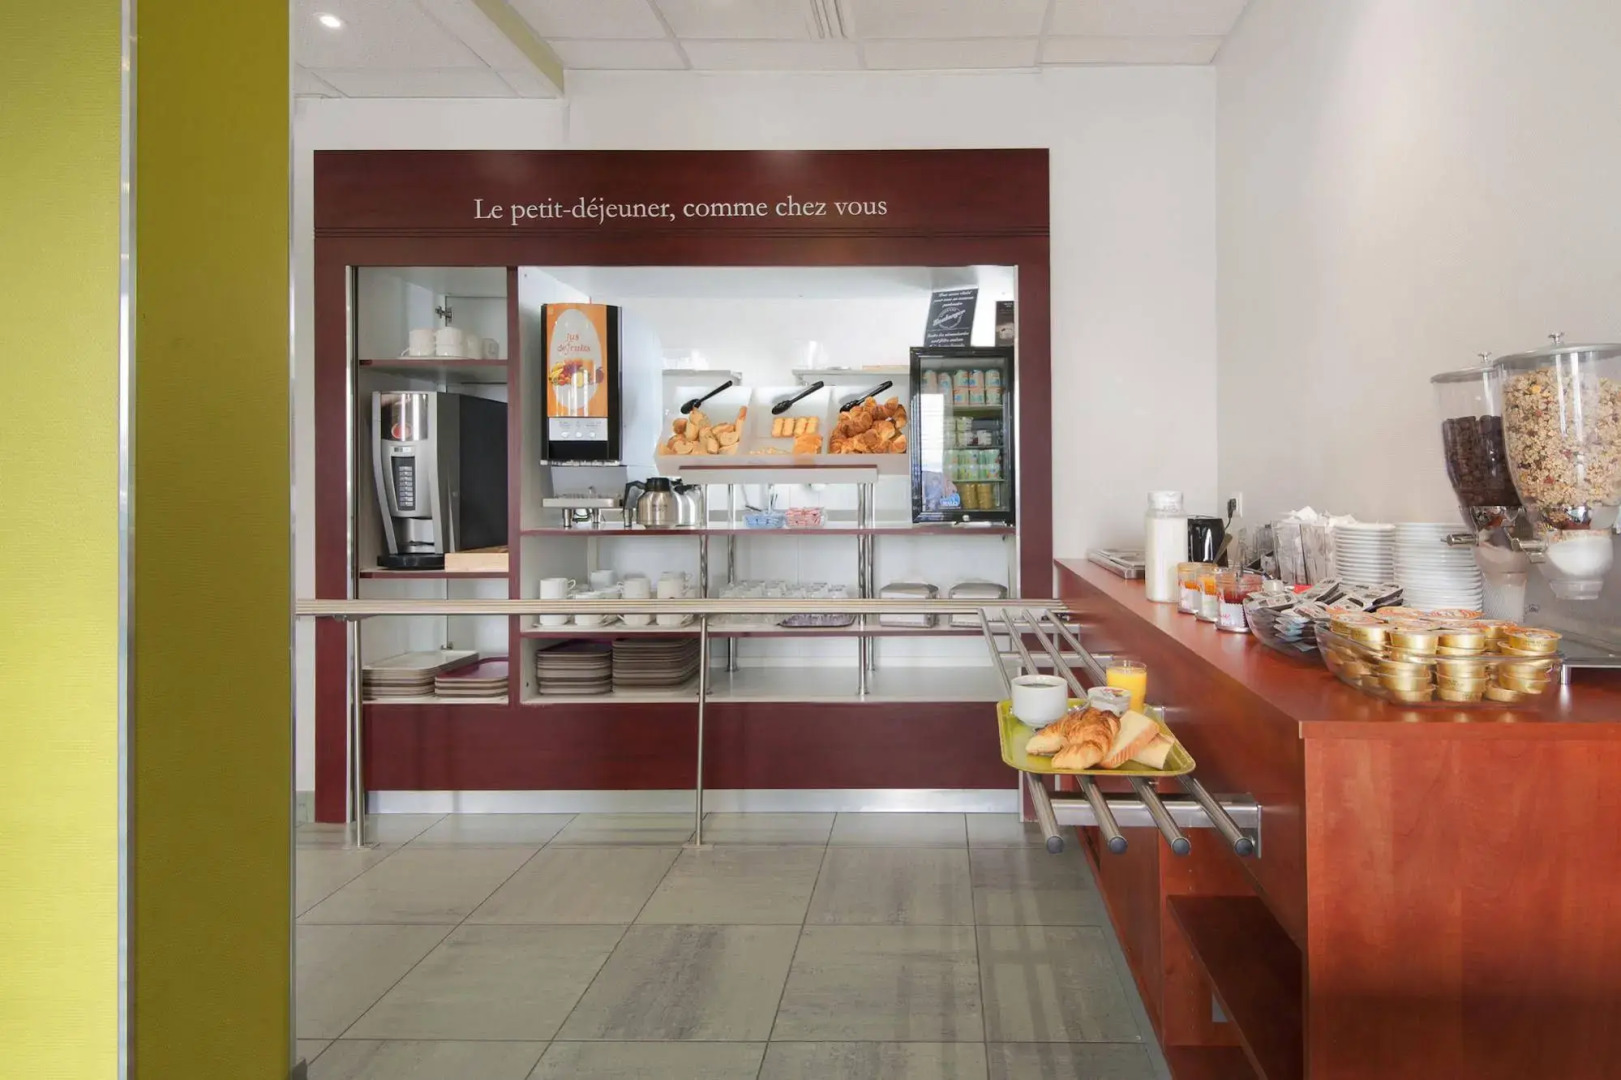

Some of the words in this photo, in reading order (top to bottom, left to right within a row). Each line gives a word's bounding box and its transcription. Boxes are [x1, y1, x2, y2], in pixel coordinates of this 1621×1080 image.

[474, 198, 504, 219] Le
[510, 196, 676, 226] petit-déjeuner,
[682, 202, 768, 218] comme
[775, 194, 827, 217] chez
[833, 200, 888, 216] vous
